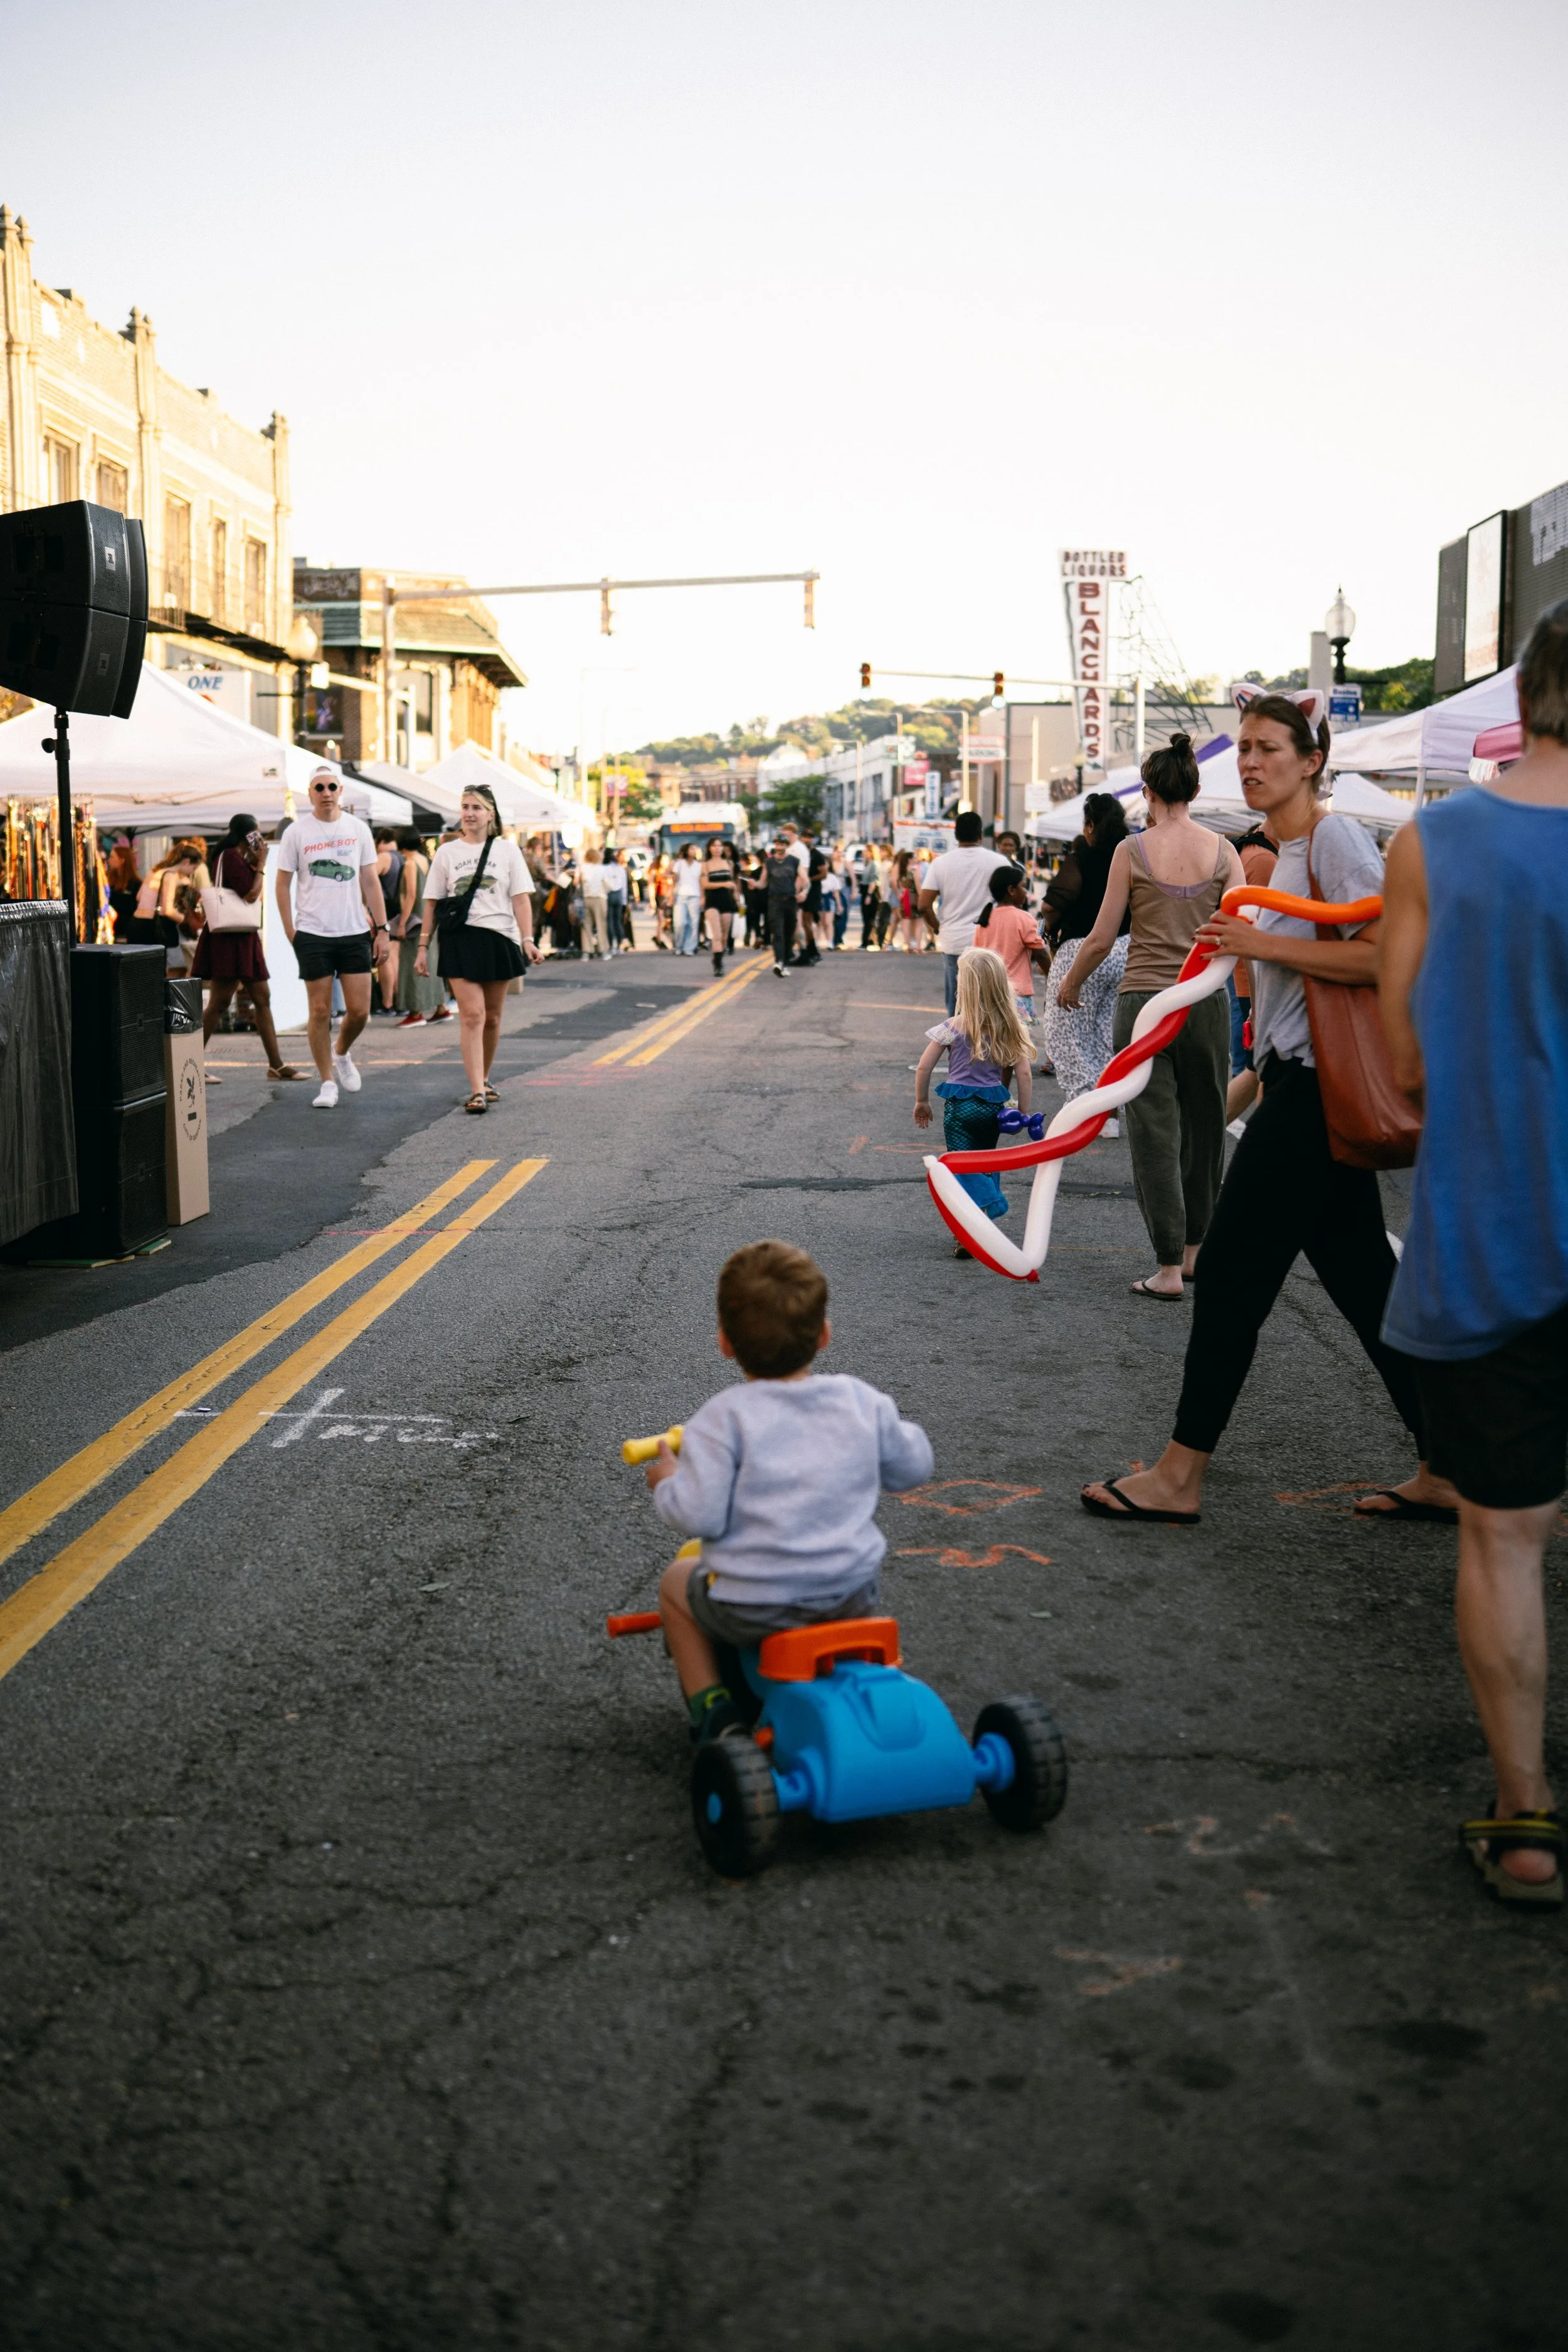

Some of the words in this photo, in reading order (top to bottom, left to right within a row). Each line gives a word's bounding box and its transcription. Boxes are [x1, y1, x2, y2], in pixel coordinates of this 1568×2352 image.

[1063, 551, 1125, 563] BOTTLED
[1062, 564, 1126, 576] LIQUORS
[454, 859, 472, 871] NOAH
[474, 858, 497, 869] KAN
